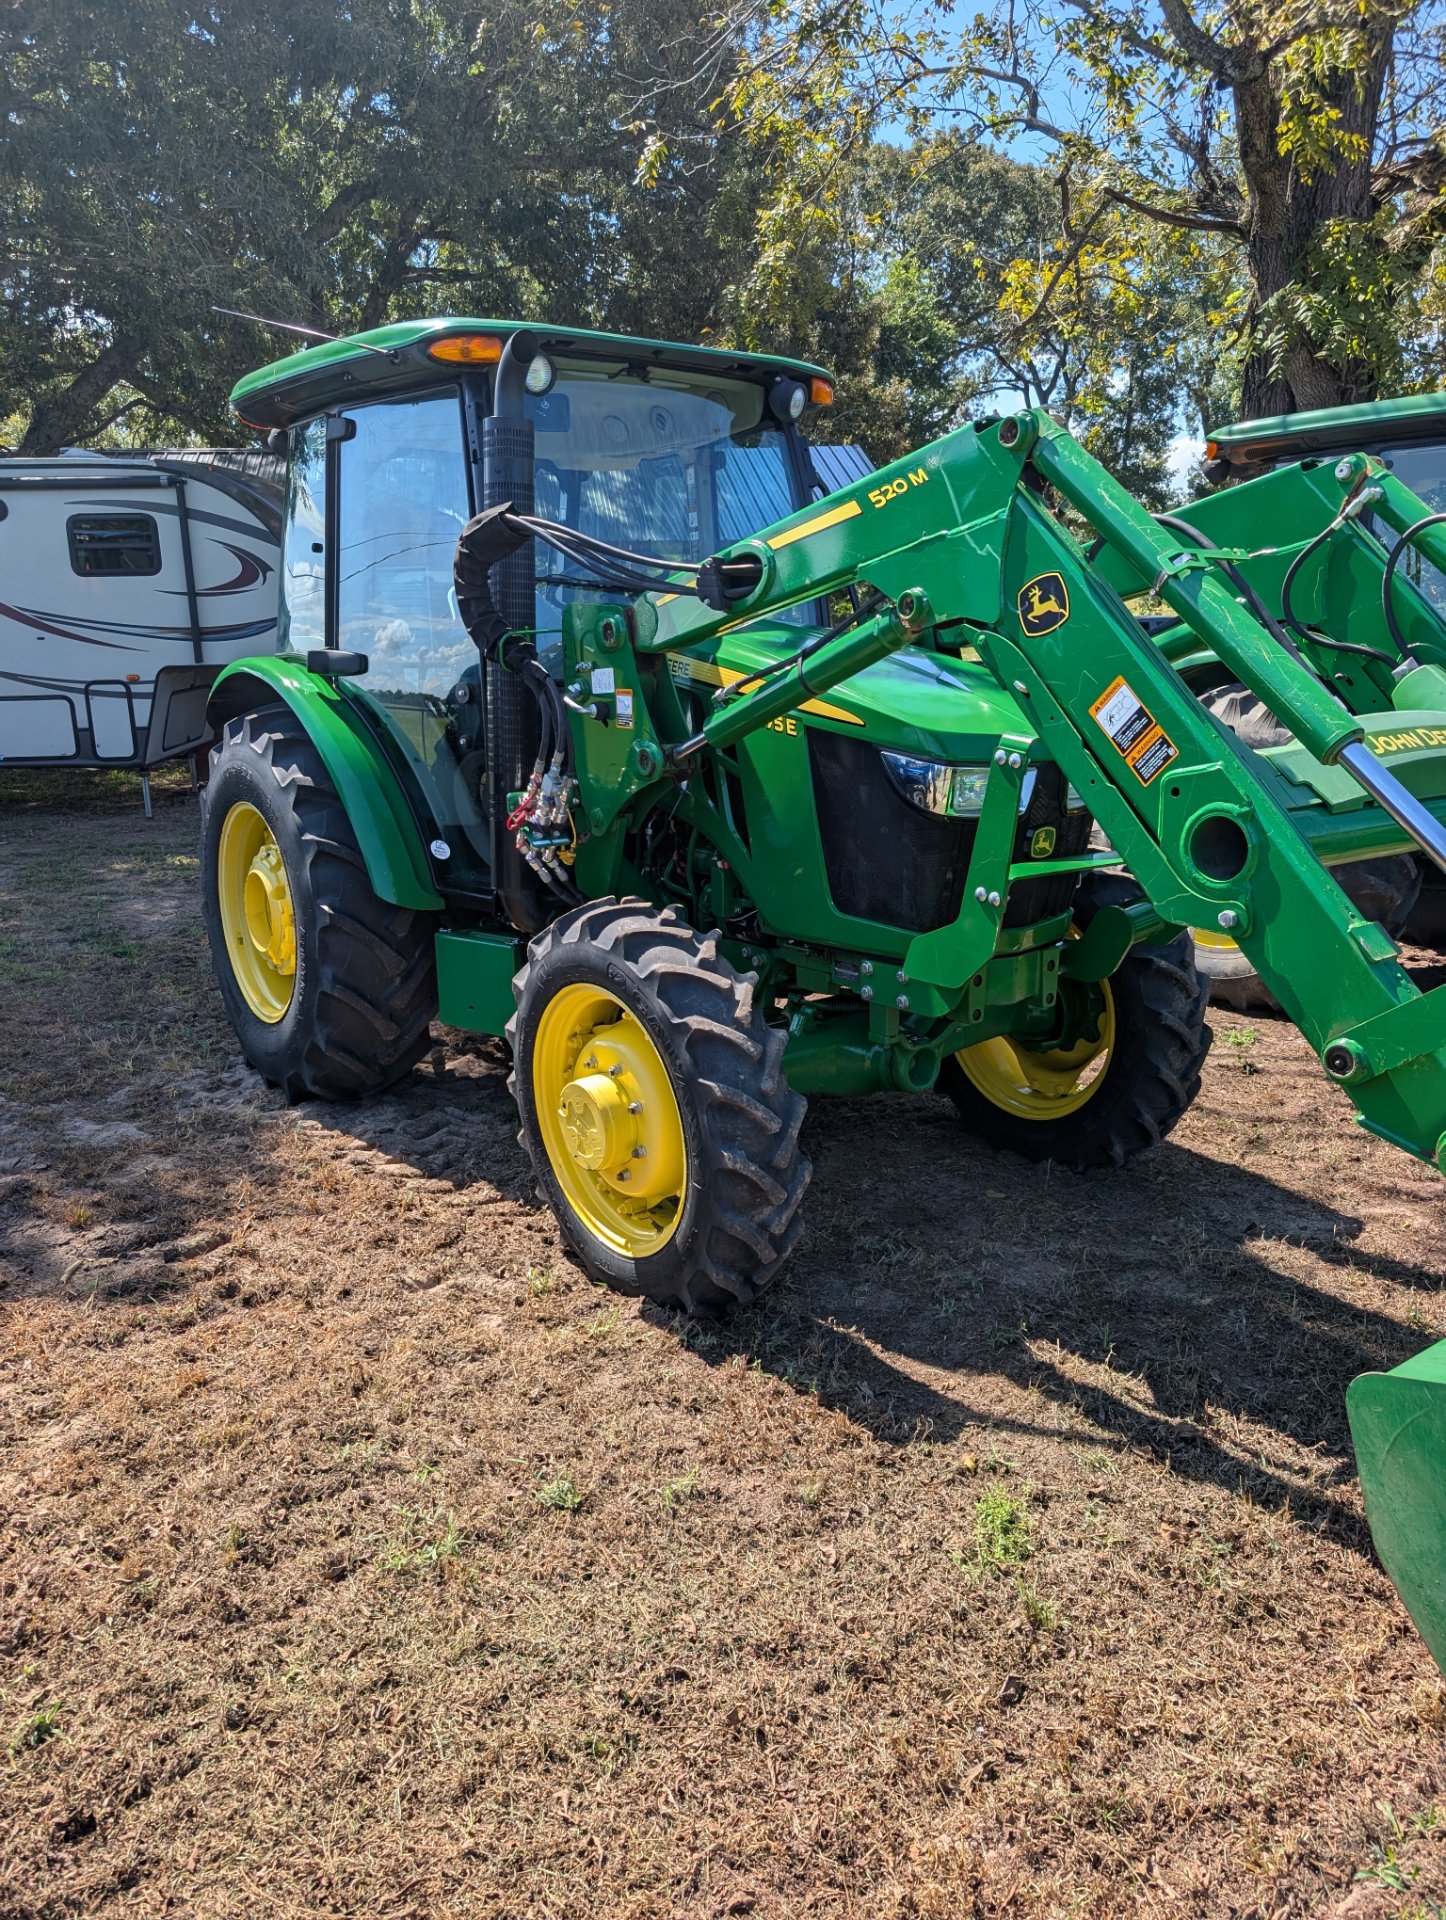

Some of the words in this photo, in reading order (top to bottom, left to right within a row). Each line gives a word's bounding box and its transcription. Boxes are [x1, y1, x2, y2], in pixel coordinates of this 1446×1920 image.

[867, 478, 908, 509] 520
[907, 468, 929, 487] M
[1099, 681, 1121, 707] WARNING
[1136, 732, 1159, 757] WARNING
[1368, 731, 1424, 754] JOHN
[1414, 727, 1446, 745] DE
